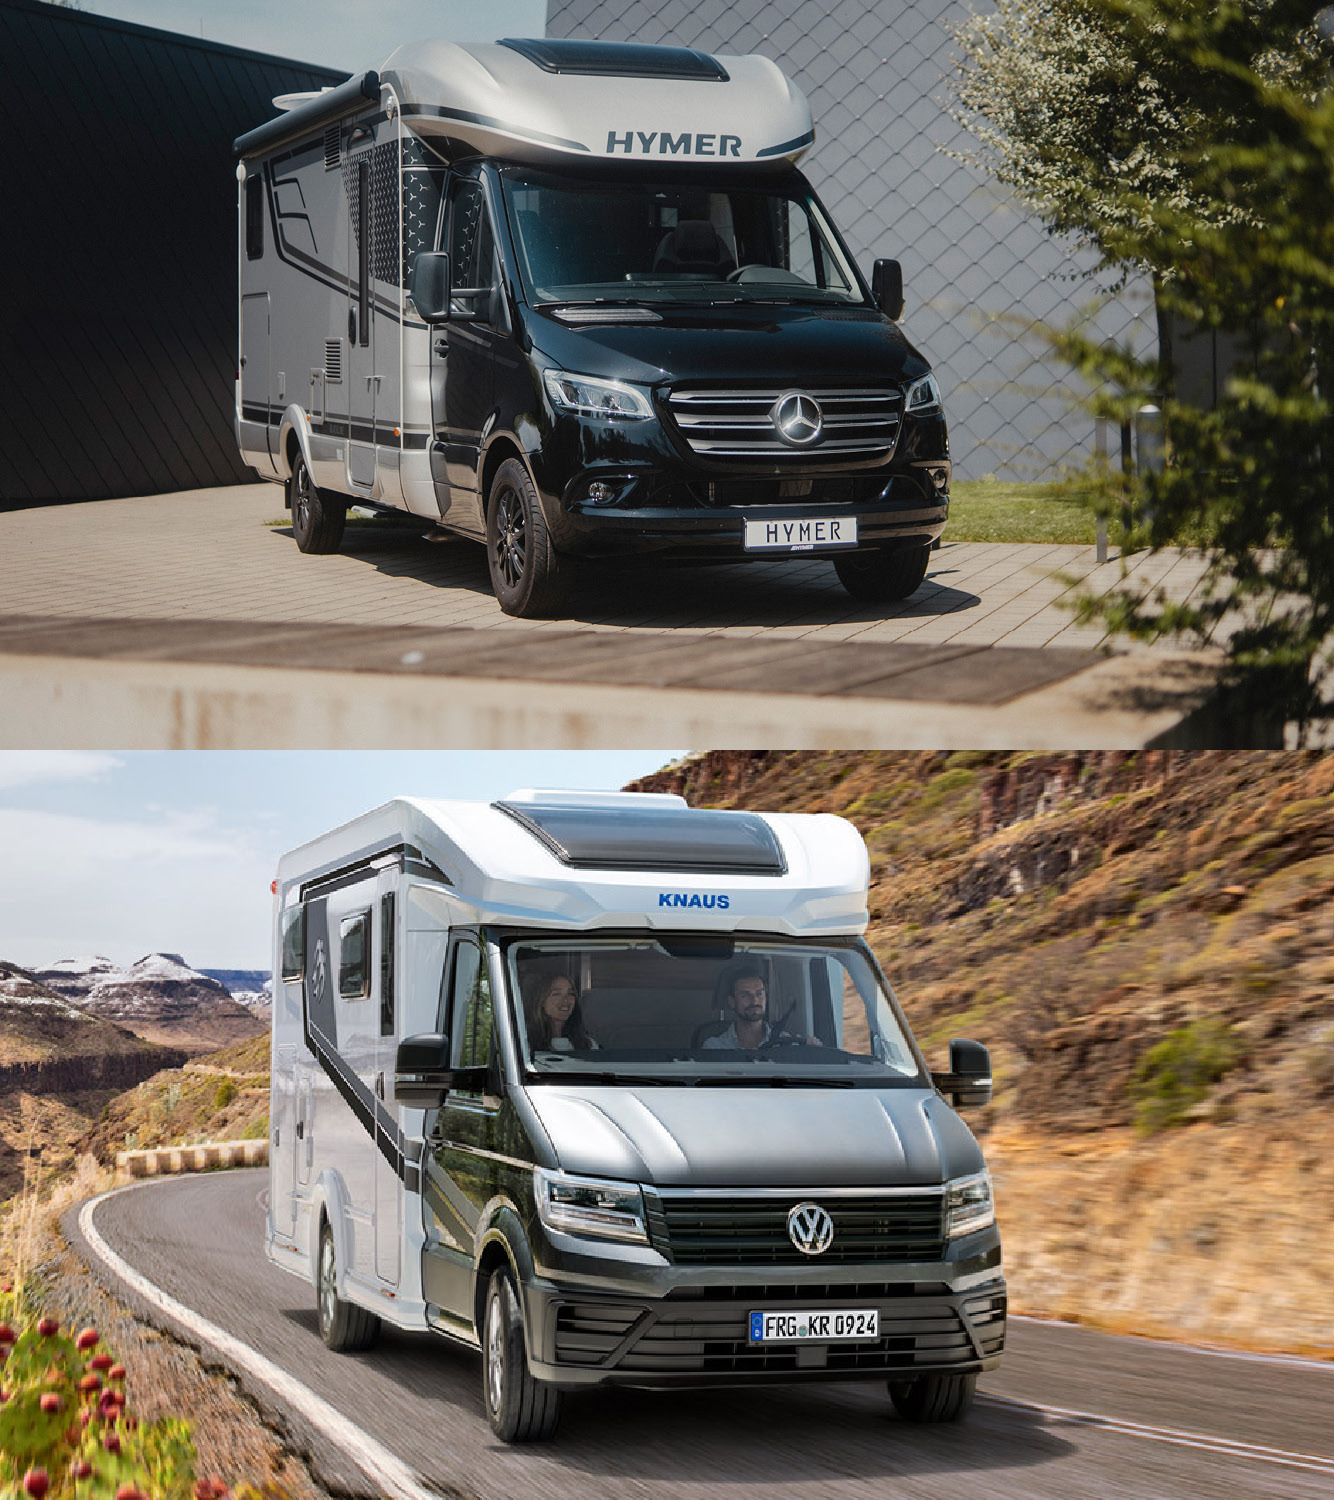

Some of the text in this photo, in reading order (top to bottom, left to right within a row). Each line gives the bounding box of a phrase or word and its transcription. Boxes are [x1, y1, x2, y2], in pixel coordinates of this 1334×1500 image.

[606, 131, 742, 157] HYMER
[766, 521, 841, 543] HYMER
[658, 893, 730, 909] KNAUS
[765, 1316, 797, 1337] FRG
[808, 1315, 830, 1336] KR
[835, 1313, 876, 1335] 0924
